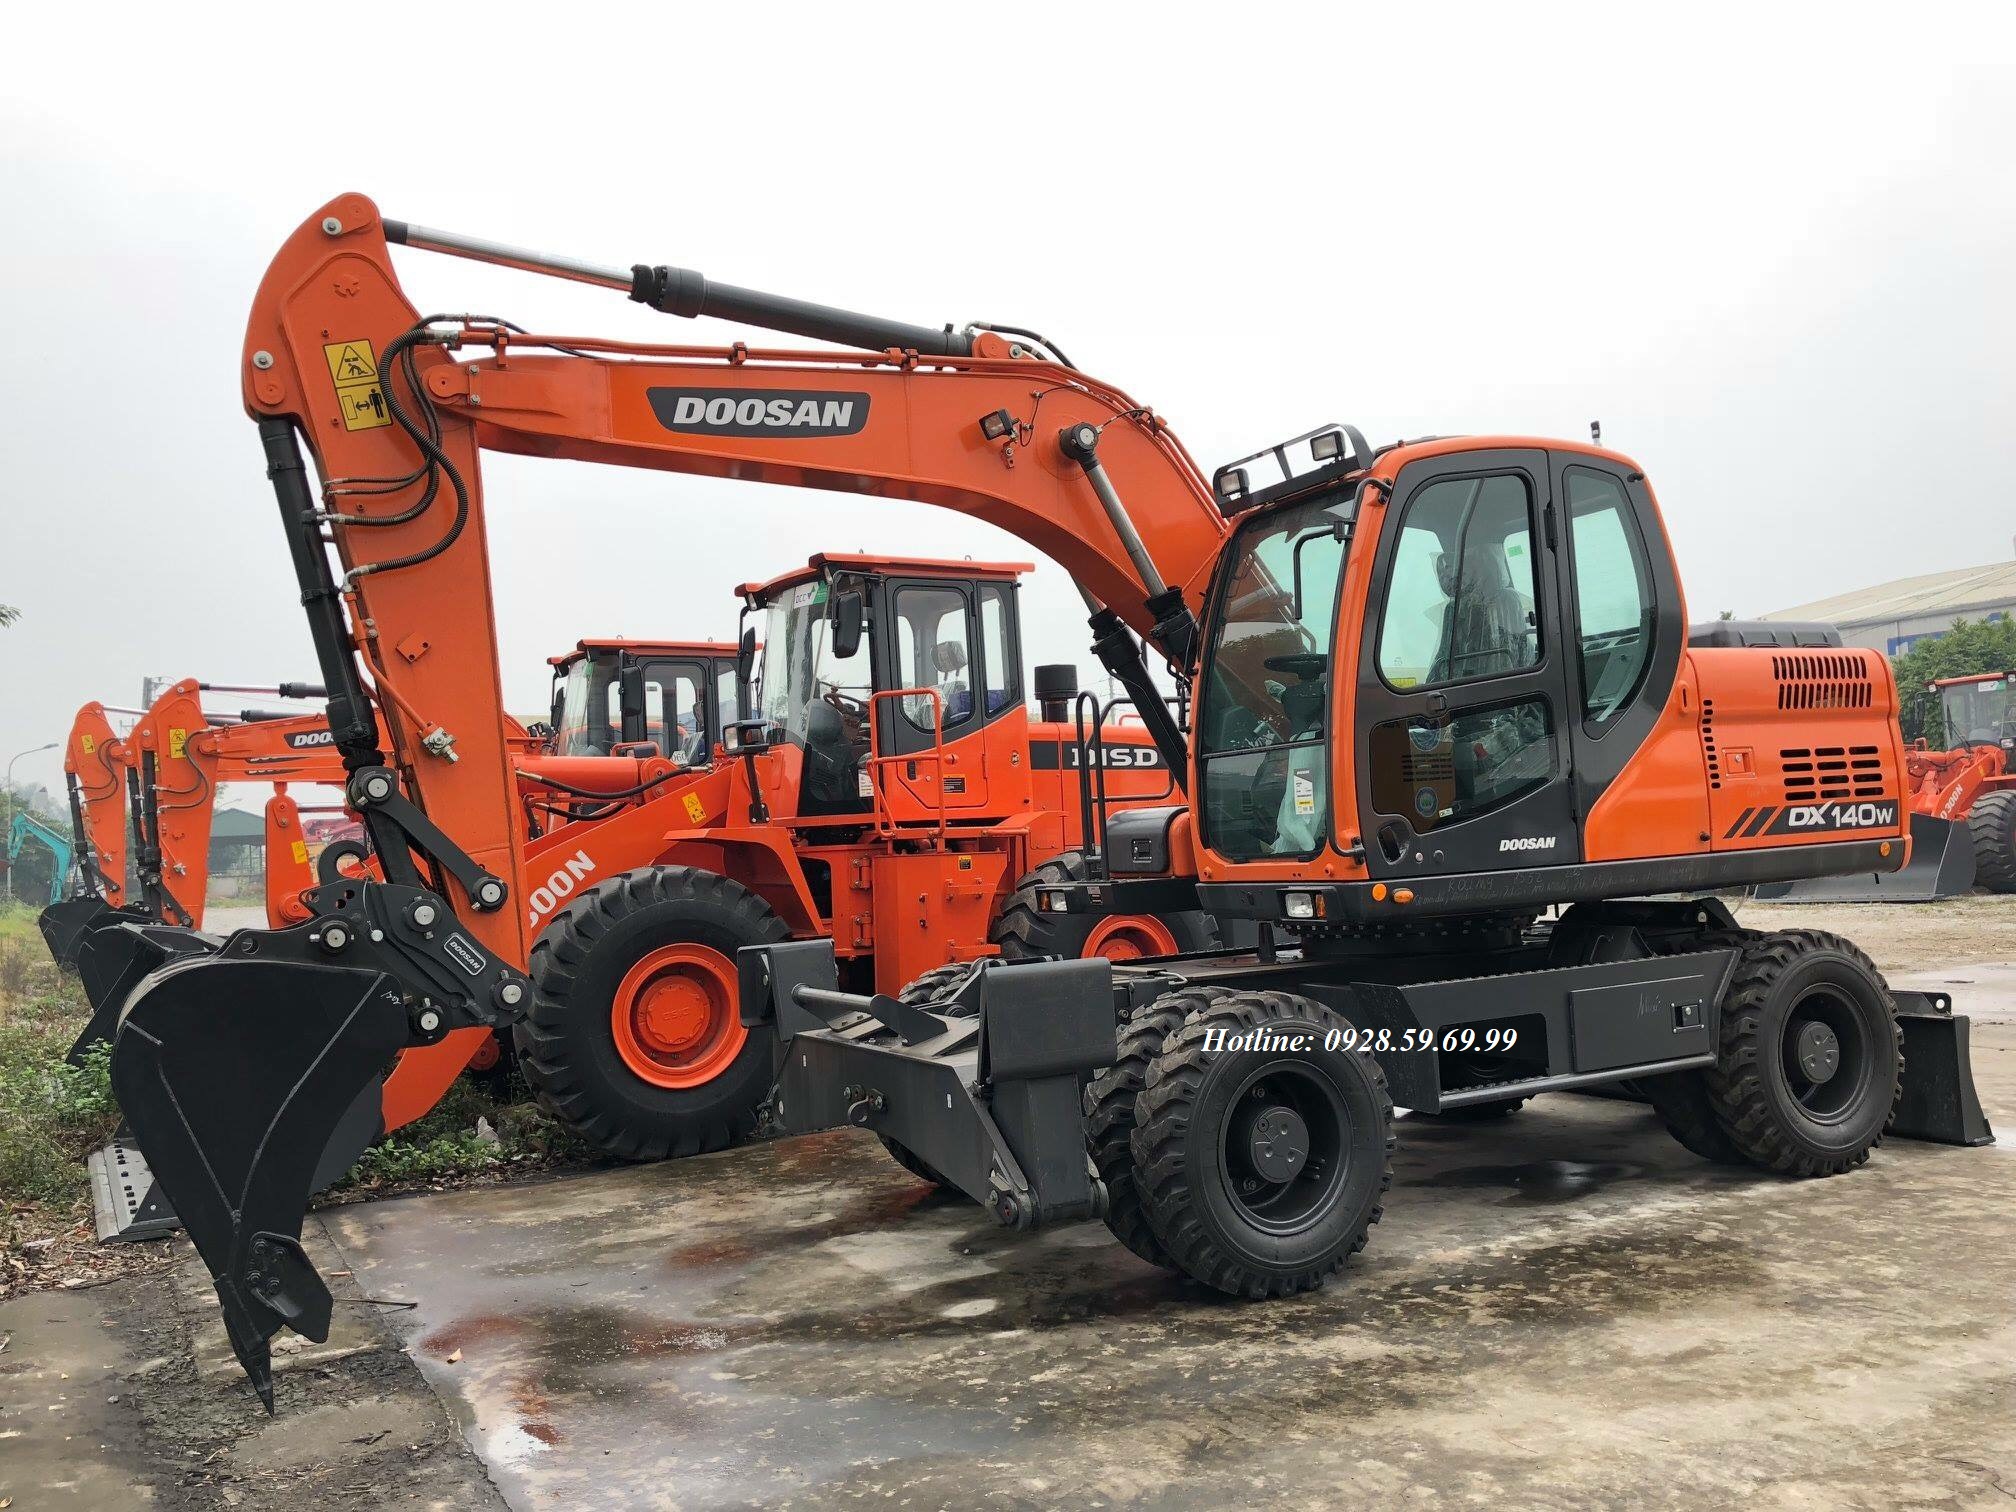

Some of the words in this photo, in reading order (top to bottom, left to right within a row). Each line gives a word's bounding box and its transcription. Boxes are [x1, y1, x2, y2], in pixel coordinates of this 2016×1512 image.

[672, 396, 854, 429] DOOSAN
[293, 731, 334, 747] DOO
[1499, 836, 1555, 853] DOOSAN
[449, 941, 481, 969] DOOSAN
